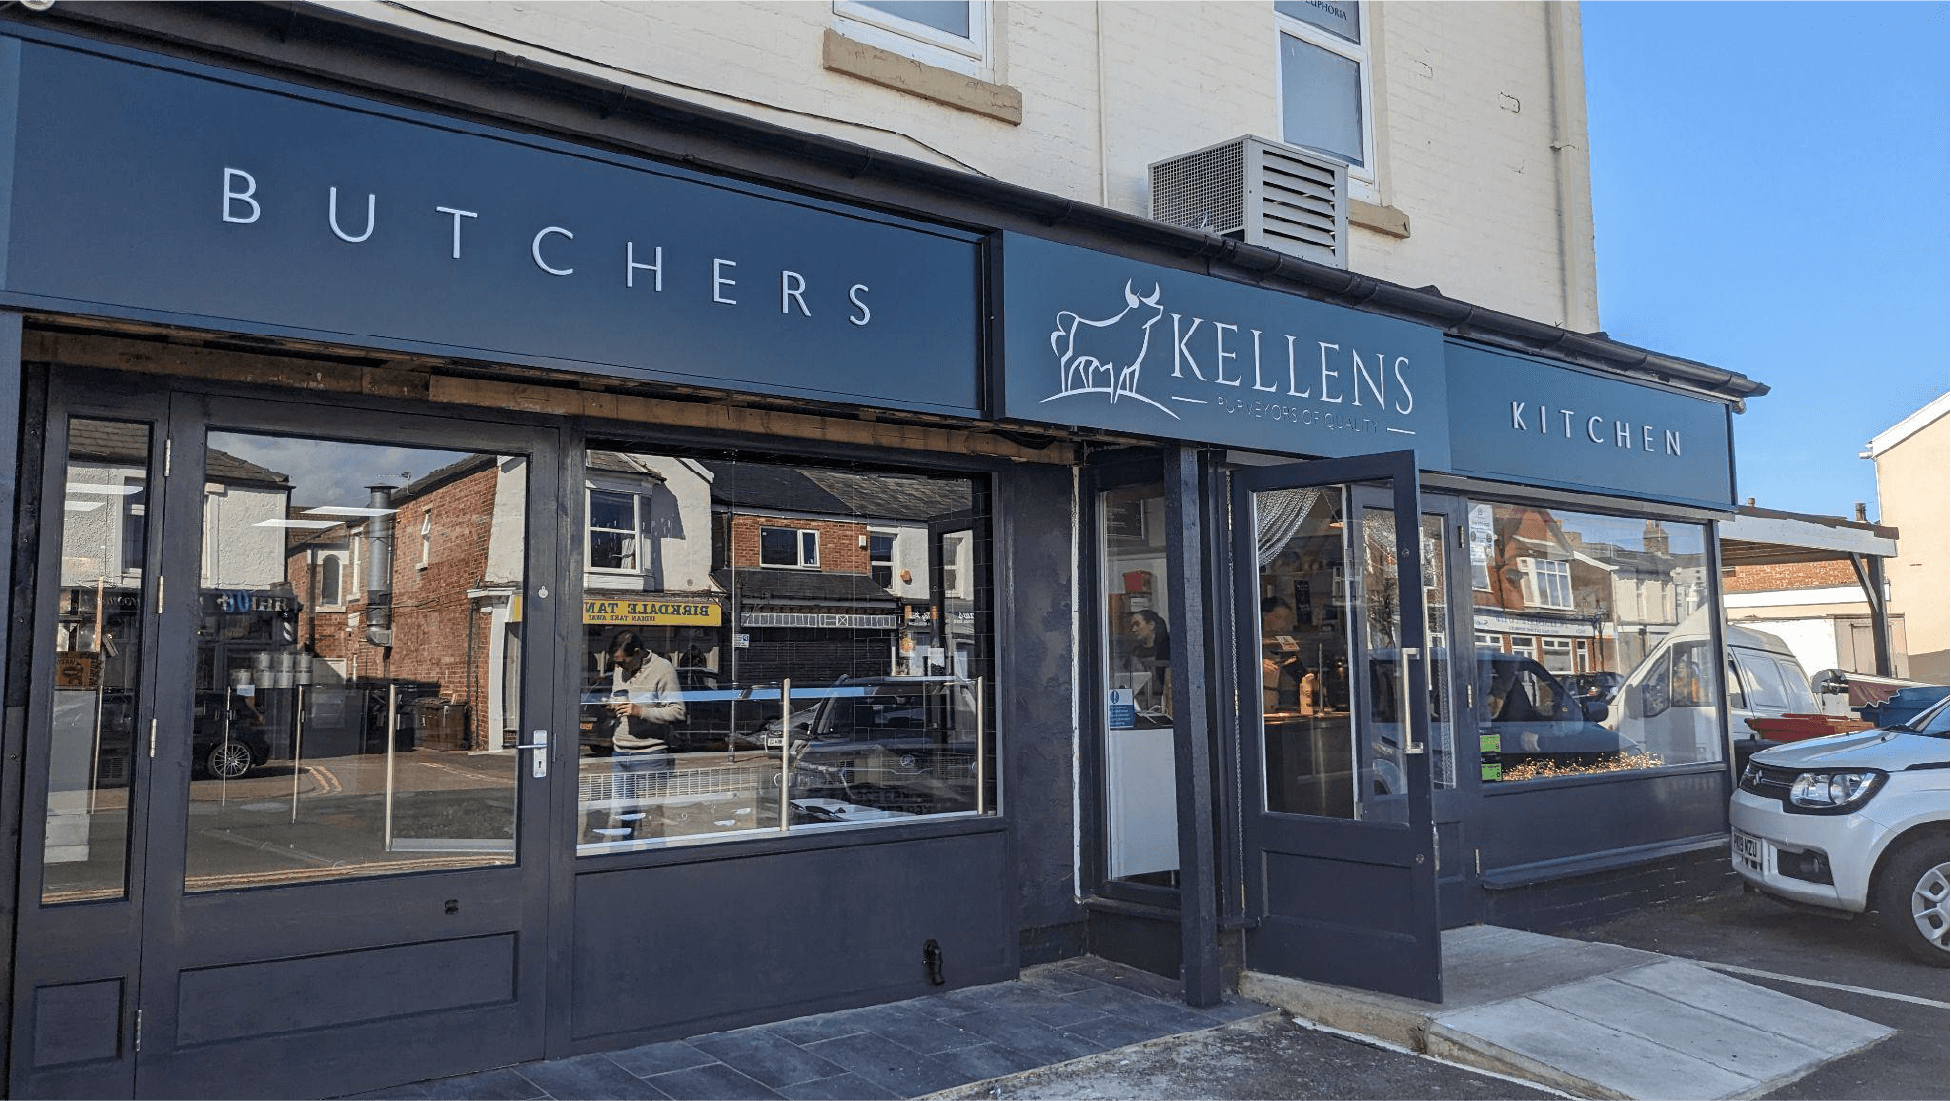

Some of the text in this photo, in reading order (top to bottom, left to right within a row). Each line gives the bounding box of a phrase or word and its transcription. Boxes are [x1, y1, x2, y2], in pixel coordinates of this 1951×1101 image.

[222, 167, 874, 328] BUTCHERS
[1170, 312, 1414, 416] KELLENS
[1217, 396, 1379, 434] PURVEYORS OF QUALITY
[1511, 400, 1684, 458] KITCHEN
